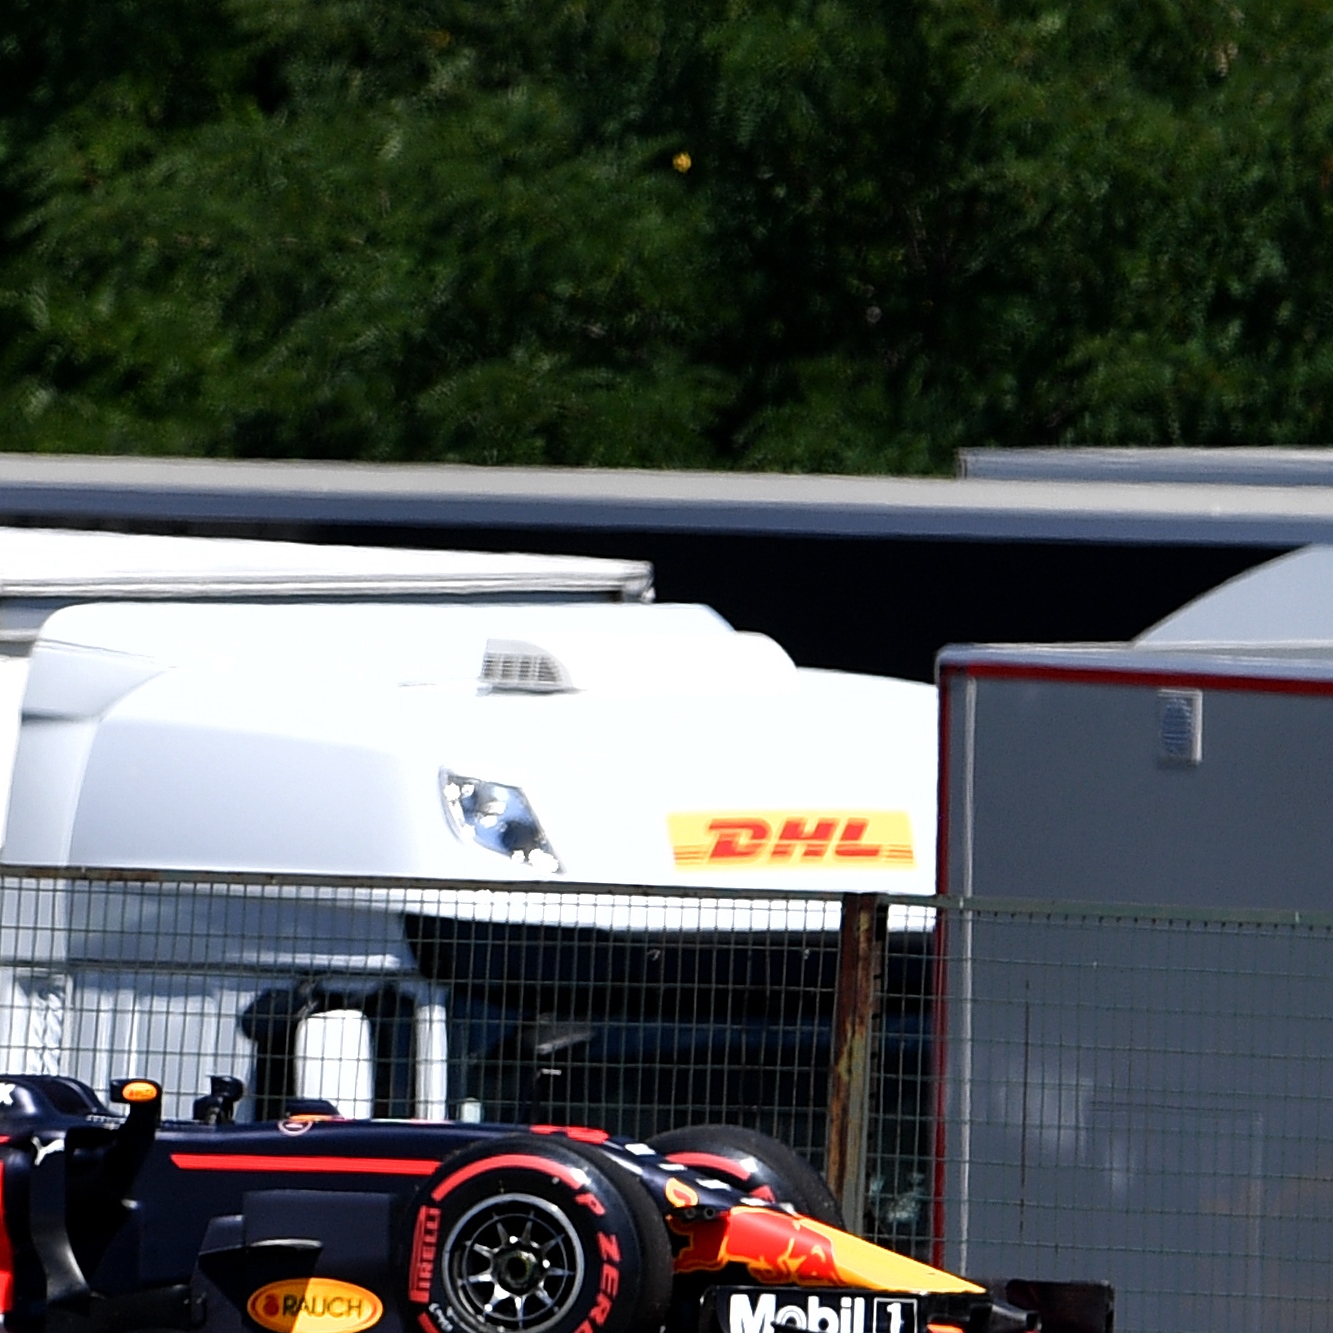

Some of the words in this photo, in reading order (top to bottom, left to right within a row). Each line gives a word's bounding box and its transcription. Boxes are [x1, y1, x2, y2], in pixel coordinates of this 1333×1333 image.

[705, 817, 883, 863] DHL
[409, 1204, 442, 1303] PIRELLI
[283, 1293, 362, 1319] RAUCH
